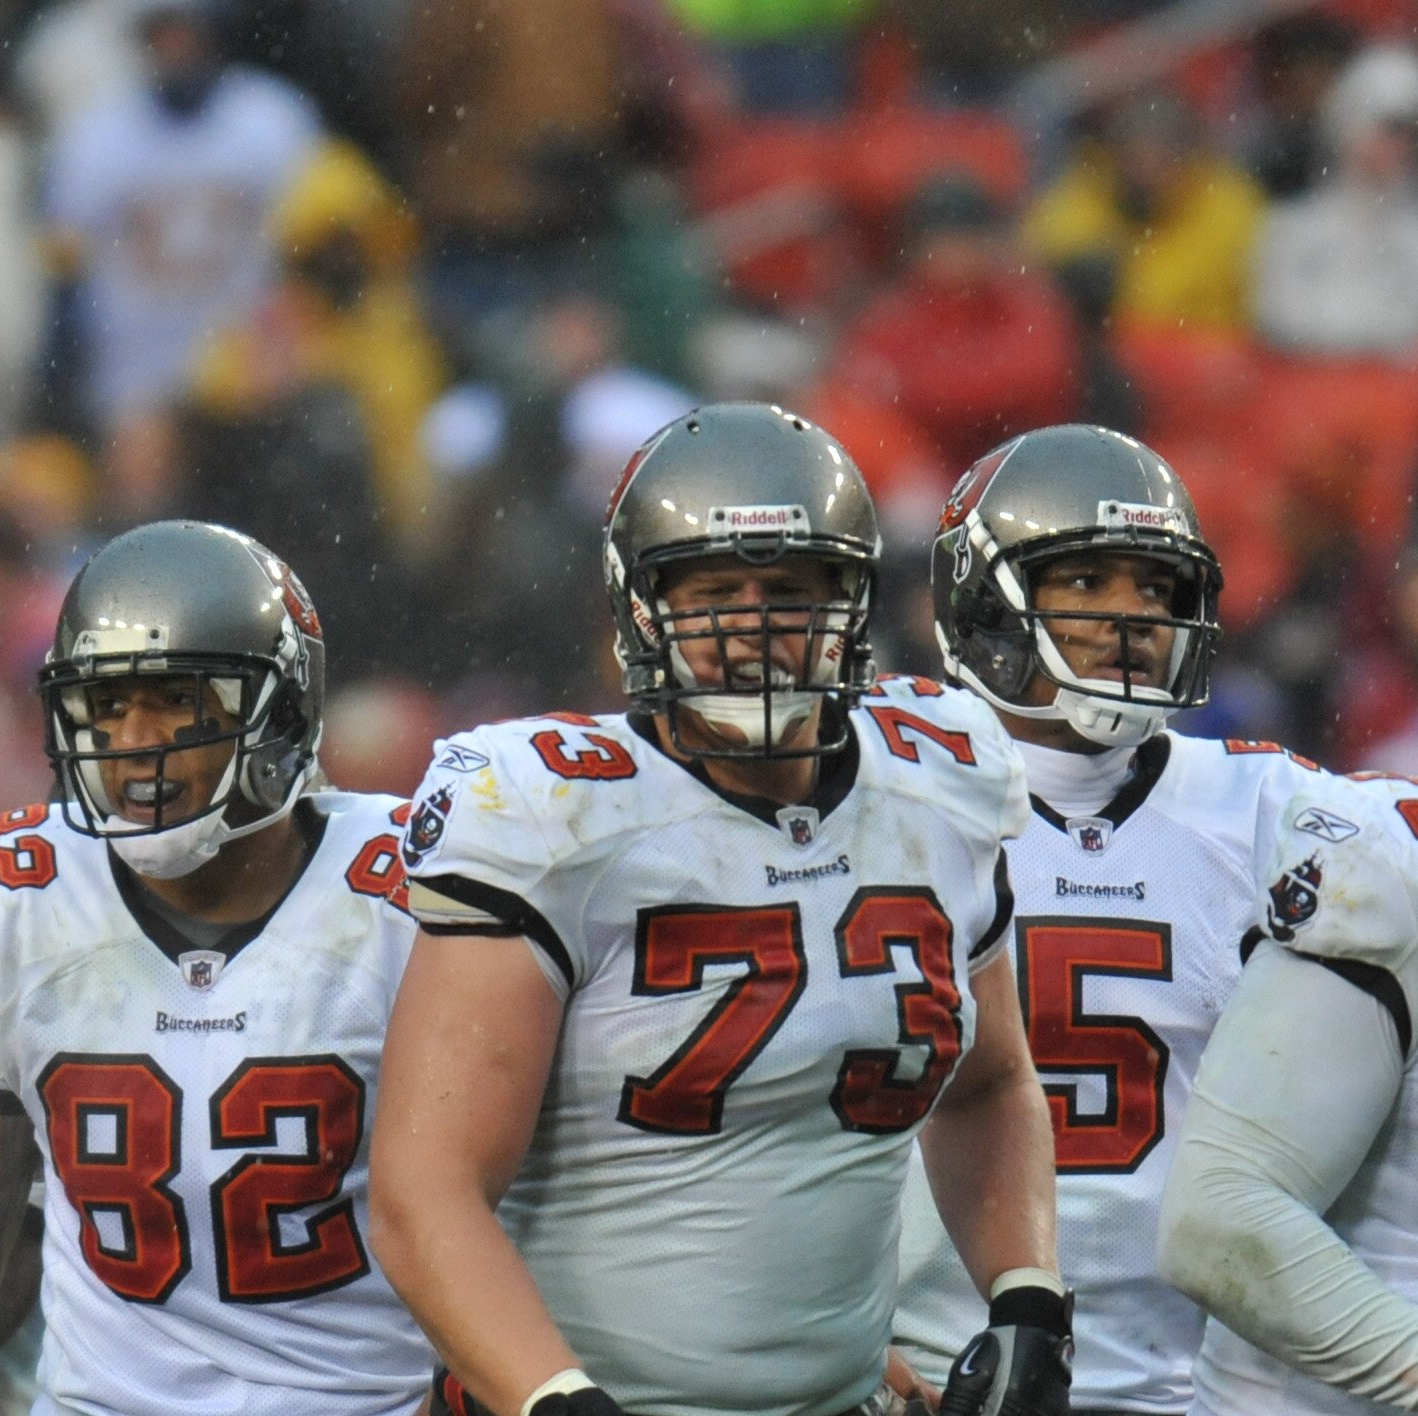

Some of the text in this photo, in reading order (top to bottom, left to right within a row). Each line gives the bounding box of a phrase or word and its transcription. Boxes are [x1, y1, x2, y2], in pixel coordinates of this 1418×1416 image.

[731, 510, 788, 526] Riddell
[616, 884, 964, 1135] 73
[37, 1051, 371, 1304] 82
